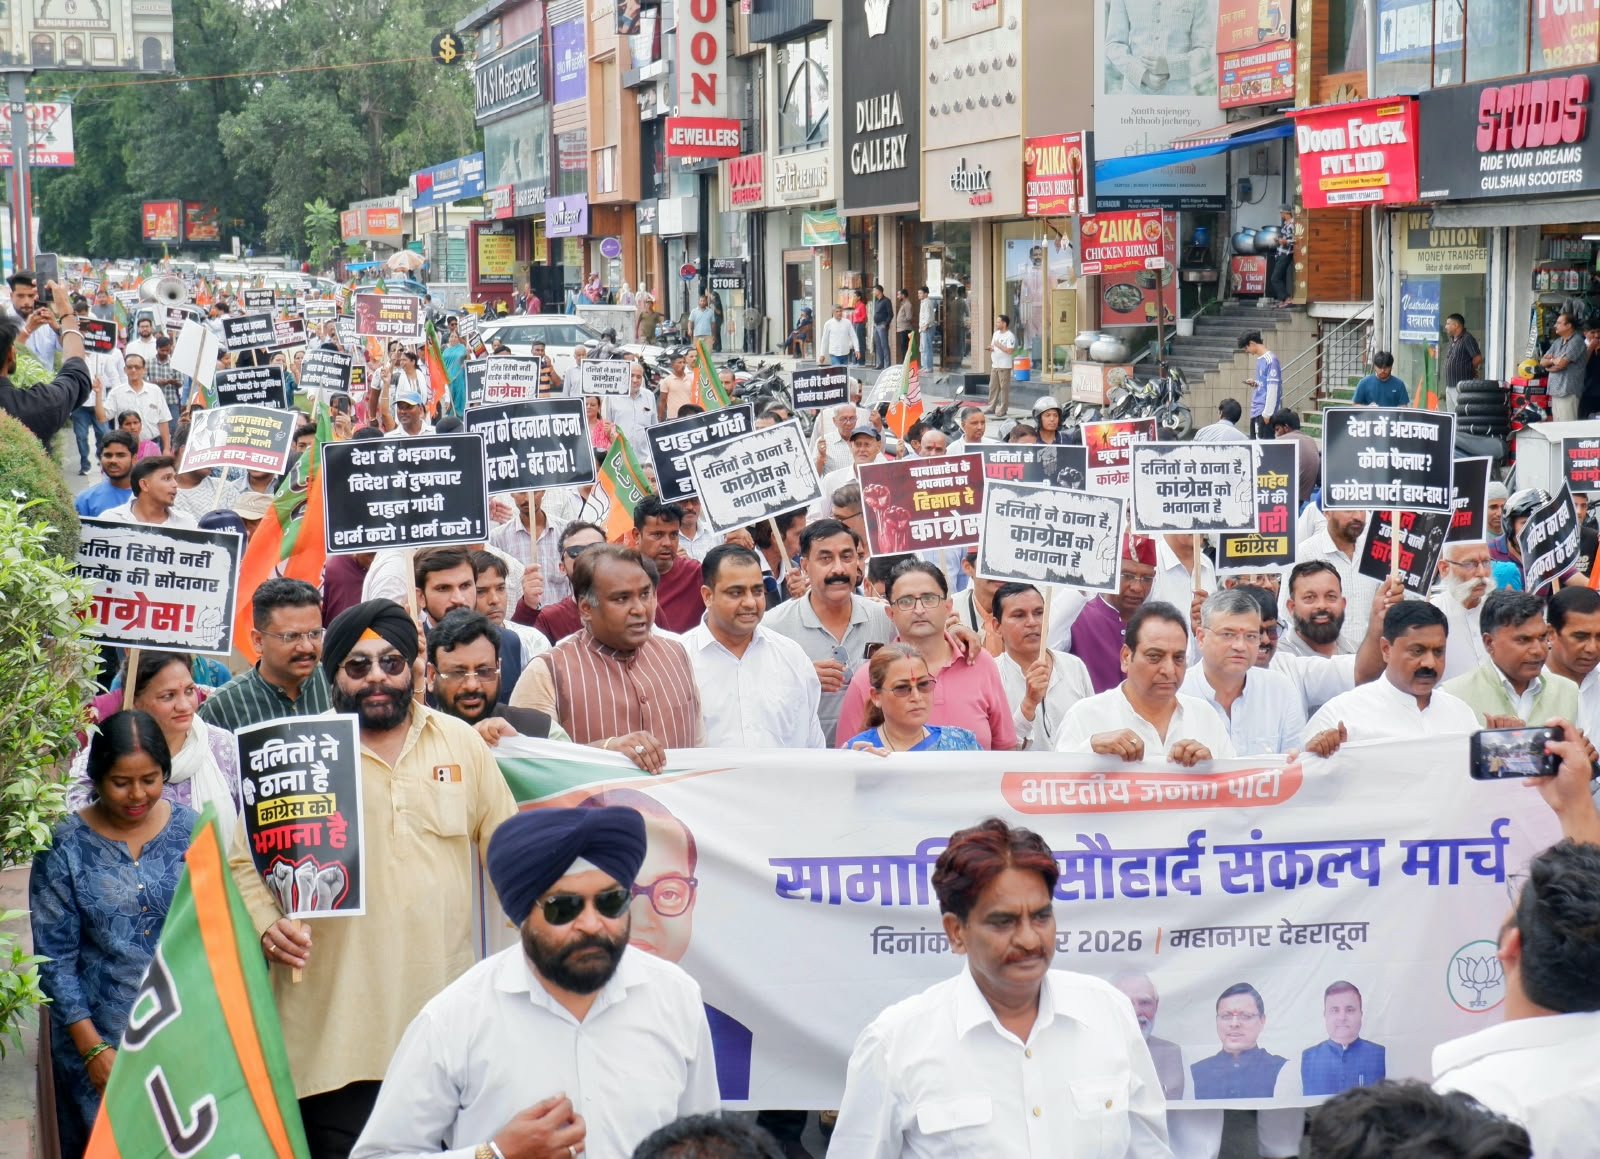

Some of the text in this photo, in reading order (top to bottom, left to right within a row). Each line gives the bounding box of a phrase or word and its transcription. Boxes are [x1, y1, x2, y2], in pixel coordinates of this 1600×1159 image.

[476, 60, 537, 109] NASIR BESPOKE
[856, 90, 904, 133] DULHA
[1476, 74, 1589, 152] STUDDS
[670, 128, 739, 147] JEWELLERS
[1297, 118, 1408, 154] Doon Forex
[851, 134, 909, 175] GALLERY
[1035, 145, 1067, 176] ZAIKA
[1480, 147, 1582, 171] RIDE YOUR DREAMS
[950, 158, 990, 194] ethnix
[1481, 168, 1583, 190] GULSHAN SCOOTERS
[1026, 181, 1052, 196] CHICKEN
[1099, 219, 1143, 243] ZAIKA
[1429, 228, 1478, 247] UNION
[1085, 243, 1158, 260] CHICKEN BIRYANI
[1418, 251, 1445, 262] MONEY
[713, 279, 739, 288] STORE
[1402, 295, 1440, 311] Vastralaya
[376, 319, 415, 334] कांग्रेस
[1406, 314, 1436, 328] वस्त्रालय
[496, 412, 581, 442] को बदनाम करना
[656, 413, 746, 452] राहुल गाँधी
[1347, 416, 1439, 442] देश में अराजकता
[189, 450, 221, 465] कांग्रेस
[351, 446, 456, 466] देश में भड़काव,
[497, 450, 518, 480] करो
[527, 446, 545, 476] बंद
[545, 443, 568, 473] करो
[701, 454, 740, 479] दलितों
[740, 451, 755, 466] ने
[756, 445, 784, 463] ठाना
[989, 451, 1034, 463] दलितों से
[1097, 449, 1119, 464] खून
[1141, 459, 1182, 475] दलितों
[1184, 460, 1197, 474] ने
[1200, 462, 1230, 475] ठाना
[1358, 447, 1432, 472] कौन फैलाए?
[720, 466, 776, 494] कांग्रेस
[775, 462, 791, 477] को
[910, 460, 971, 477] बाबासाहेब के
[348, 473, 388, 492] विदेश
[391, 471, 409, 488] में
[916, 475, 968, 489] अपमान का
[1156, 476, 1231, 498] कांग्रेस को
[1331, 478, 1401, 502] कांग्रेस पार्टी
[367, 493, 445, 519] राहुल गांधी
[733, 481, 788, 508] भगाना है
[913, 488, 974, 512] हिसाब दे
[1163, 498, 1222, 515] भगाना है
[1271, 490, 1287, 504] की
[995, 500, 1041, 523] दलितों
[1045, 505, 1058, 522] ने
[1062, 509, 1095, 528] ठाना
[1547, 515, 1559, 536] का
[334, 525, 363, 545] शर्म
[366, 523, 396, 542] करो
[410, 519, 438, 539] शर्म
[441, 517, 471, 537] करो
[1010, 521, 1094, 552] कांग्रेस को
[1408, 533, 1426, 550] वाली
[79, 539, 215, 568] दलित हितैषी नहीं
[1234, 534, 1278, 554] कांग्रेस
[1556, 541, 1565, 568] के
[1015, 546, 1082, 569] भगाना है
[126, 567, 220, 593] की सौदागर
[249, 733, 339, 773] दलितों ने
[258, 760, 330, 798] ठाना है
[1021, 773, 1131, 805] भारतीय
[260, 796, 333, 823] कांग्रेस को
[253, 811, 348, 854] भगाना है
[1213, 829, 1386, 895] संकल्प
[1399, 818, 1511, 886] मार्च
[1077, 930, 1142, 953] 2026
[1170, 923, 1272, 950] महानगर
[1278, 917, 1371, 952] देहरादून
